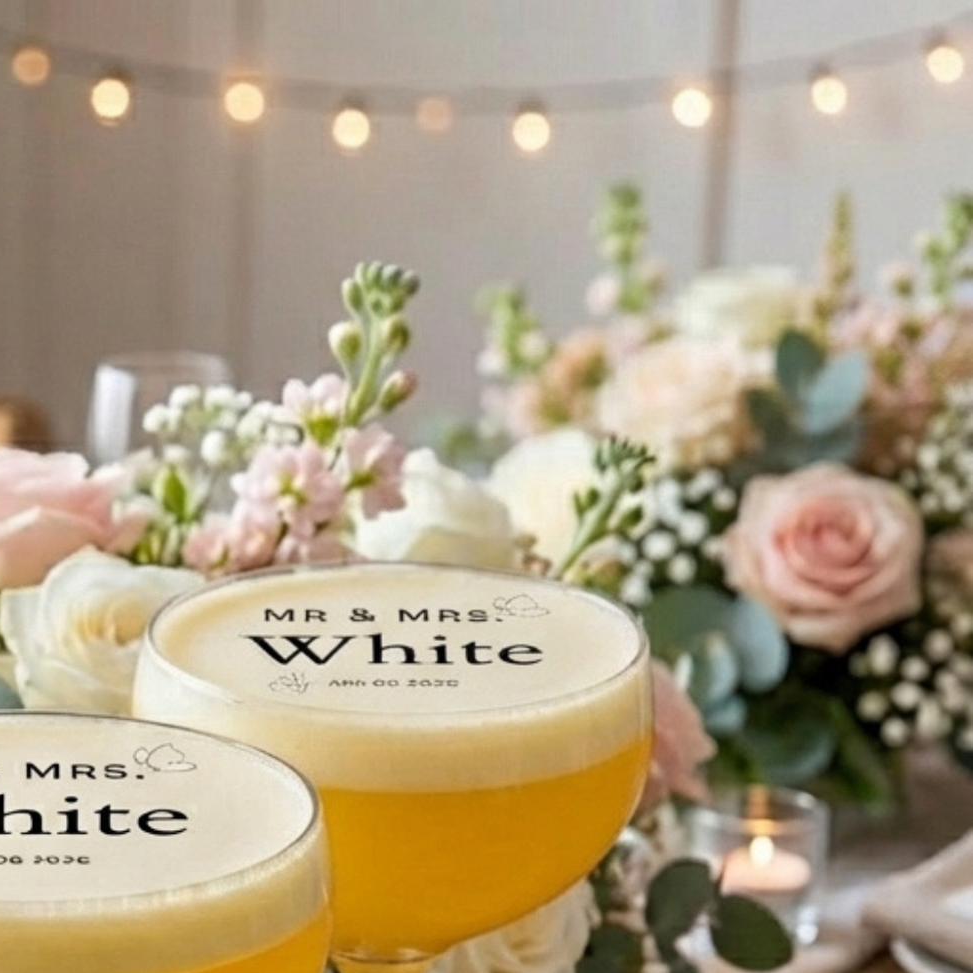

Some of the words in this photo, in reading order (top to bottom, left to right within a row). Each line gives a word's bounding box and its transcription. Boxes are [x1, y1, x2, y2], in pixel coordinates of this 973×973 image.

[264, 608, 327, 622] MR
[349, 608, 375, 622] &
[398, 608, 504, 622] MRS.
[241, 632, 544, 665] White
[26, 762, 144, 780] MRS.
